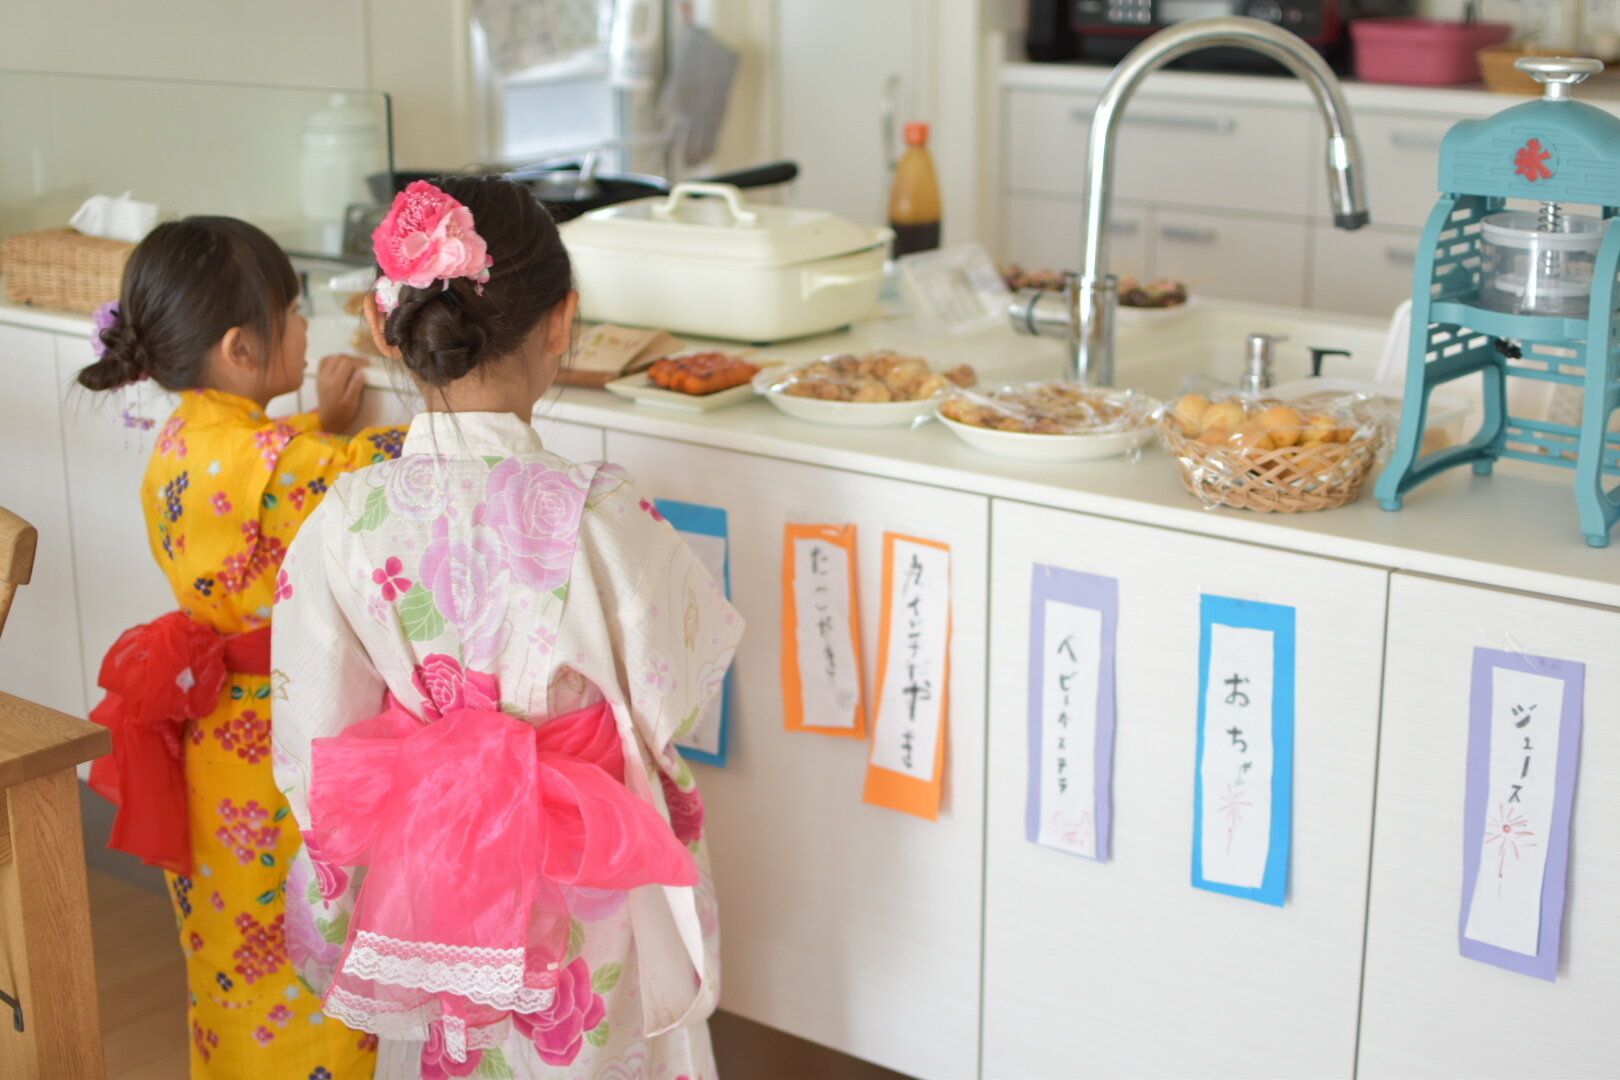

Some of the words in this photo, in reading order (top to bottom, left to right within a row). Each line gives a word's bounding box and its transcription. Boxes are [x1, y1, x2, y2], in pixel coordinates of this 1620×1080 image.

[1223, 672, 1253, 786] おちゃ
[1508, 703, 1538, 803] ジュース
